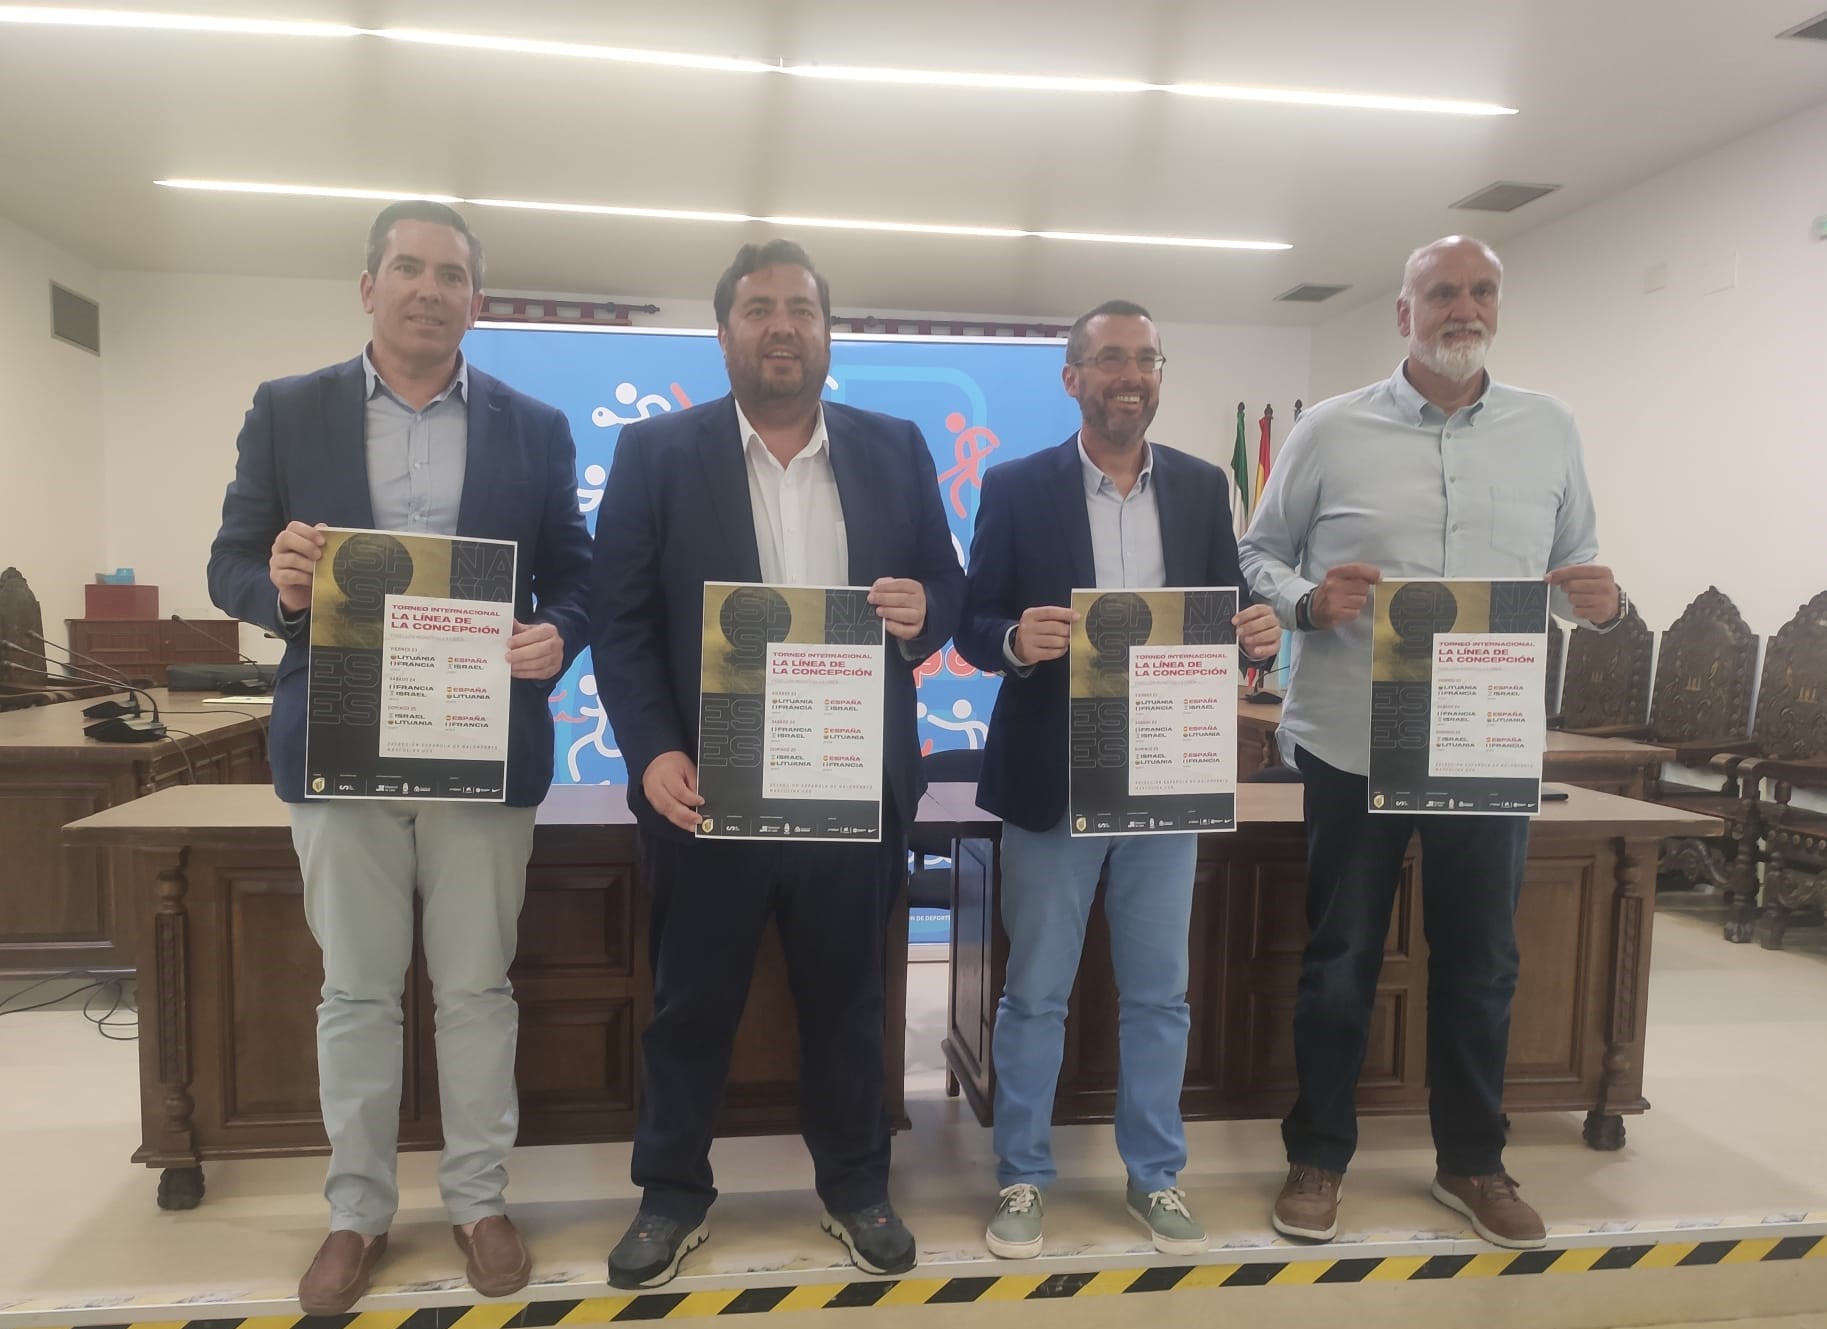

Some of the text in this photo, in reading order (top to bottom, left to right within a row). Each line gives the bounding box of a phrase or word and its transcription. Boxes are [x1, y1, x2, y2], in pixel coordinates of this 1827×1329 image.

[430, 607, 501, 617] INTERNACIONAL
[413, 613, 451, 623] LÍNEA
[391, 621, 500, 635] LA CONCEPCIÓN
[397, 654, 436, 662] LITUANIA
[454, 656, 488, 664] ESPAÑA
[1456, 656, 1535, 664] CONCEPCIÓN
[791, 659, 826, 668] LÍNEA
[791, 668, 873, 677] CONCEPCIÓN
[1153, 668, 1228, 676] CONCEPCIÓN
